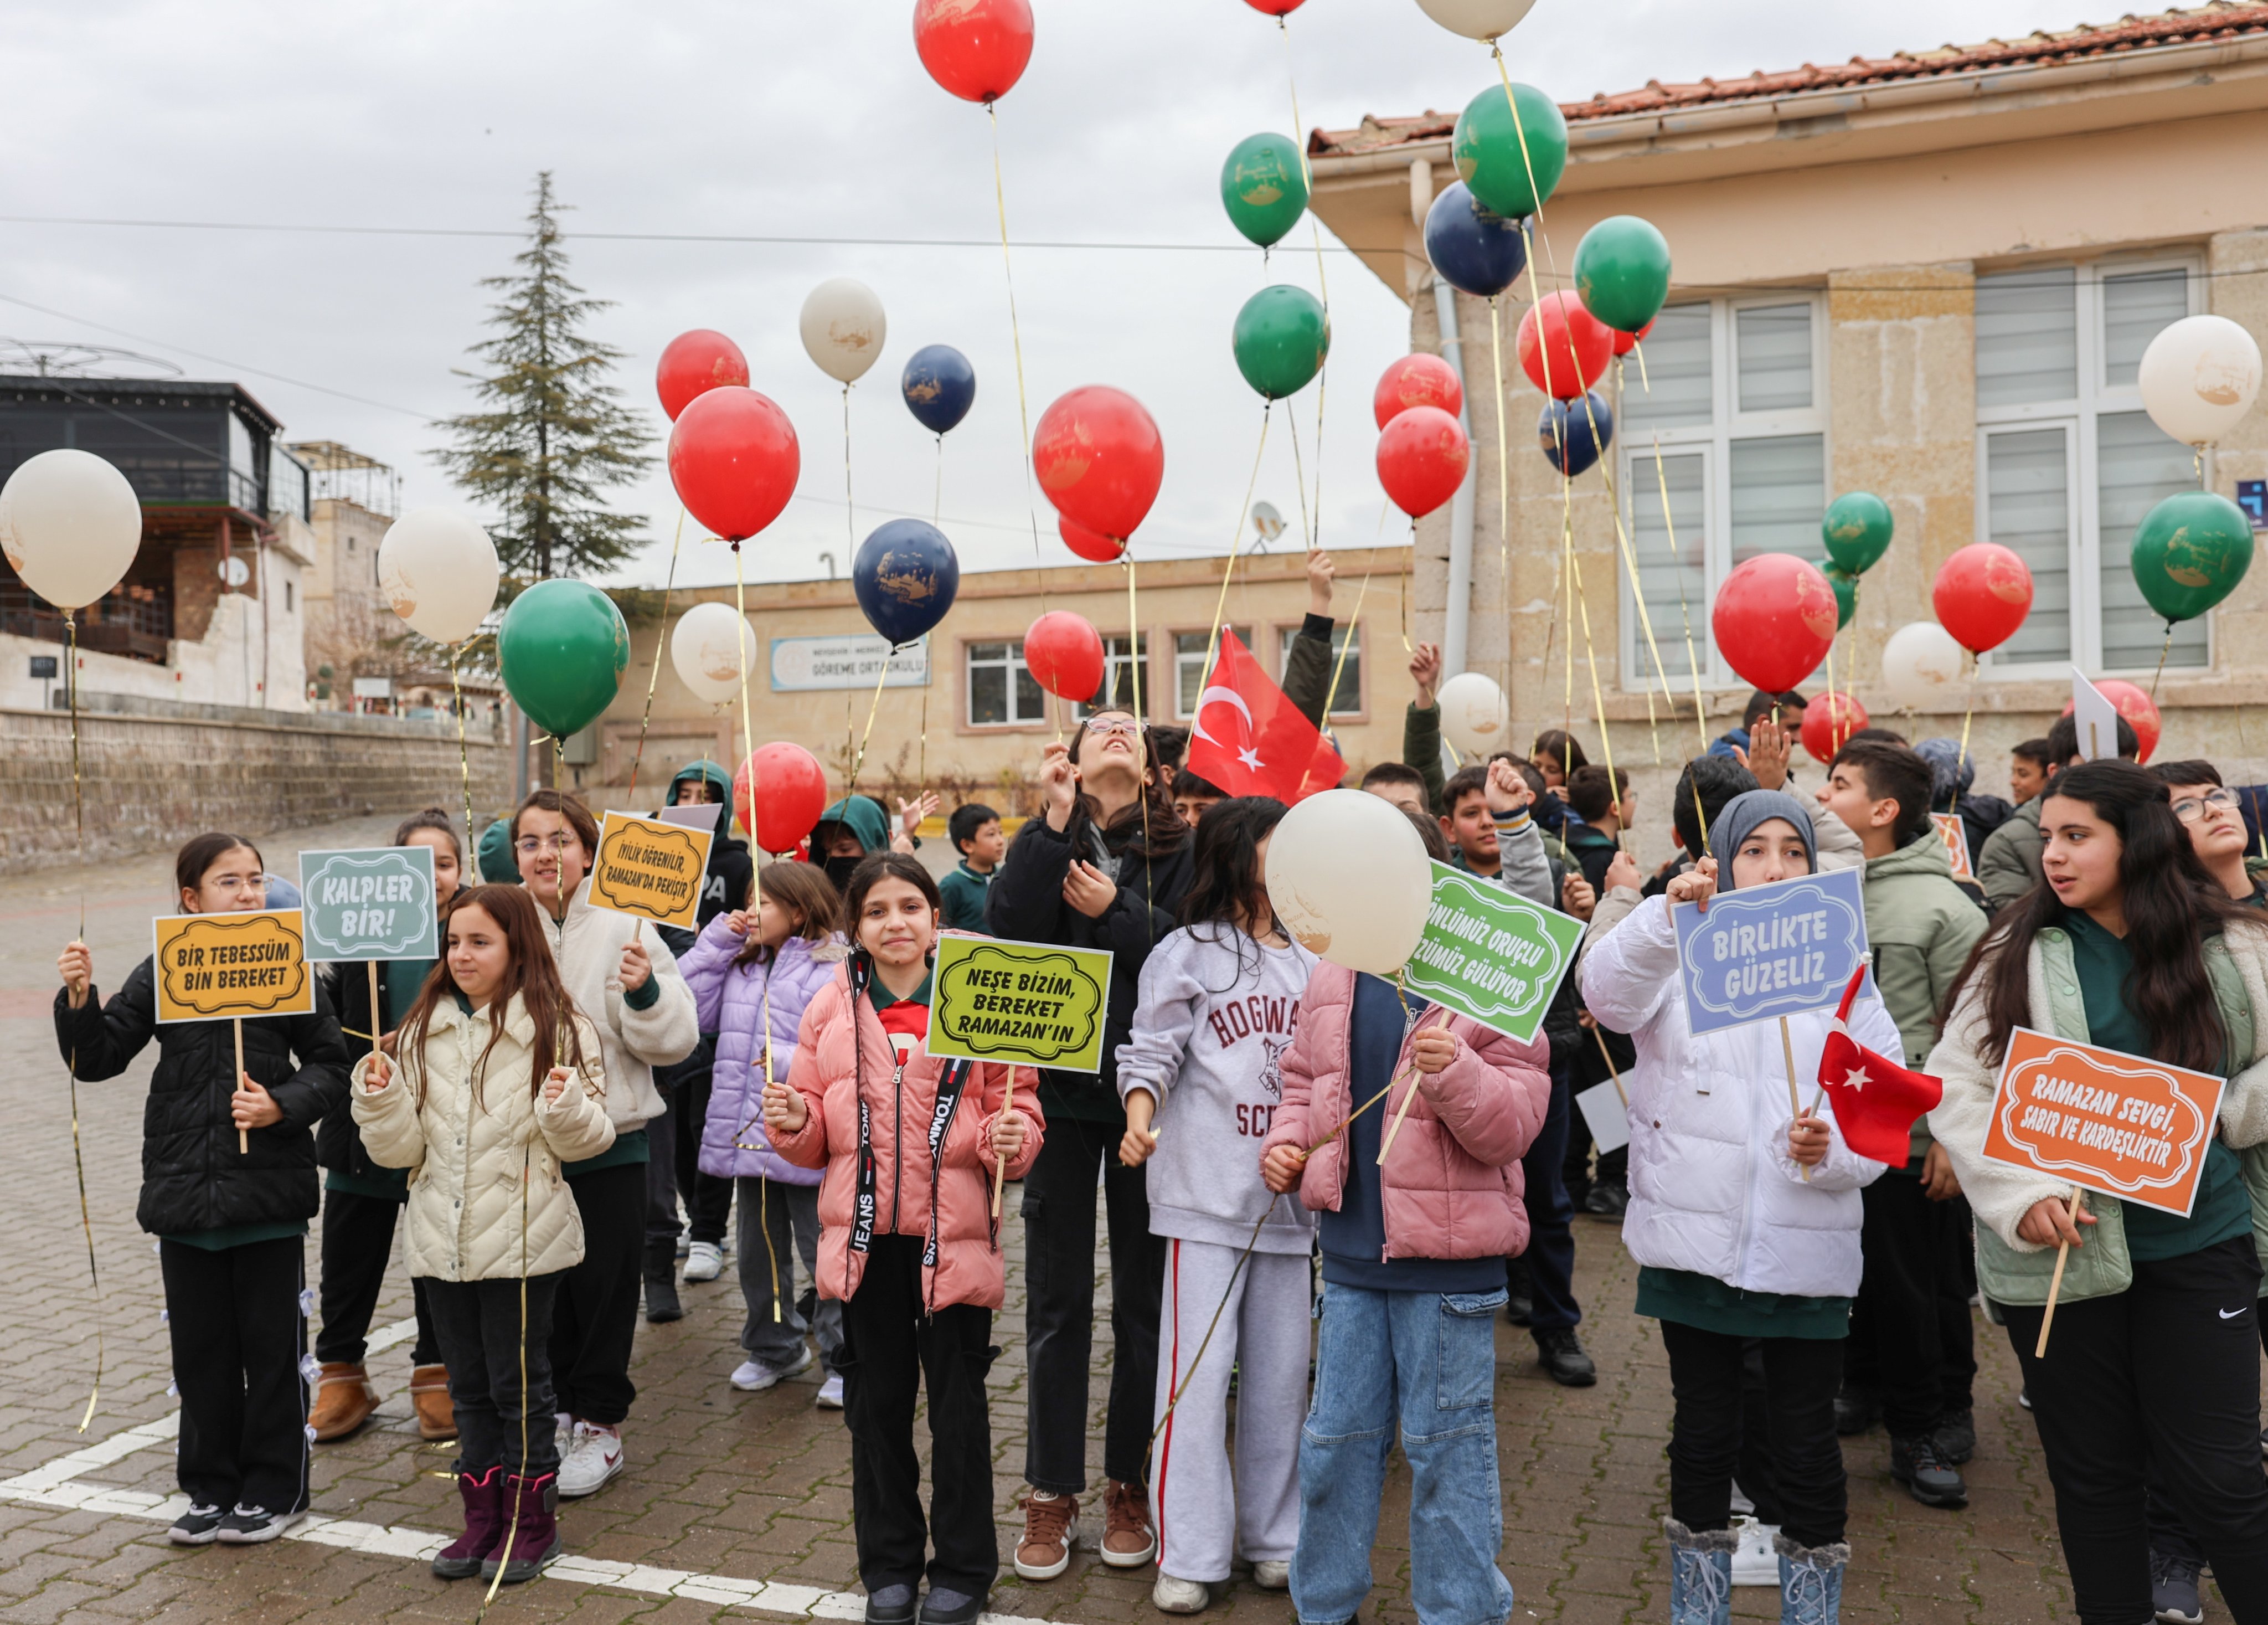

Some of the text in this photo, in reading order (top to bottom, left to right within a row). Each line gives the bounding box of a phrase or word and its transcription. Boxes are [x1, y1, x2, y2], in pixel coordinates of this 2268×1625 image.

[812, 661, 856, 677] GÖREME
[617, 840, 684, 875] İYİLİK ÖĞRENİLİR,
[322, 874, 413, 906] KALPLER
[606, 866, 688, 901] RAMAZAN'DA PEKİŞİR
[341, 903, 396, 938] BİR!
[1427, 896, 1545, 967] ÖNLÜMÜZ ORUÇLU
[1713, 910, 1827, 961] BİRLİKTE
[177, 938, 290, 967] BİR TEBESSÜM
[1414, 931, 1527, 1004] ZÜMÜZ GÜLÜYOR
[184, 967, 287, 991] BİN BEREKET
[966, 968, 1075, 999] NEŞE BİZİM,
[1725, 945, 1825, 1000] GÜZELİZ
[973, 994, 1064, 1018] BEREKET
[958, 1015, 1074, 1042] RAMAZAN'IN
[2030, 1074, 2177, 1137] RAMAZAN SEVGİ,
[2020, 1105, 2172, 1168] SABIR VE KARDEŞLİKTİR
[854, 1194, 873, 1253] JEANS
